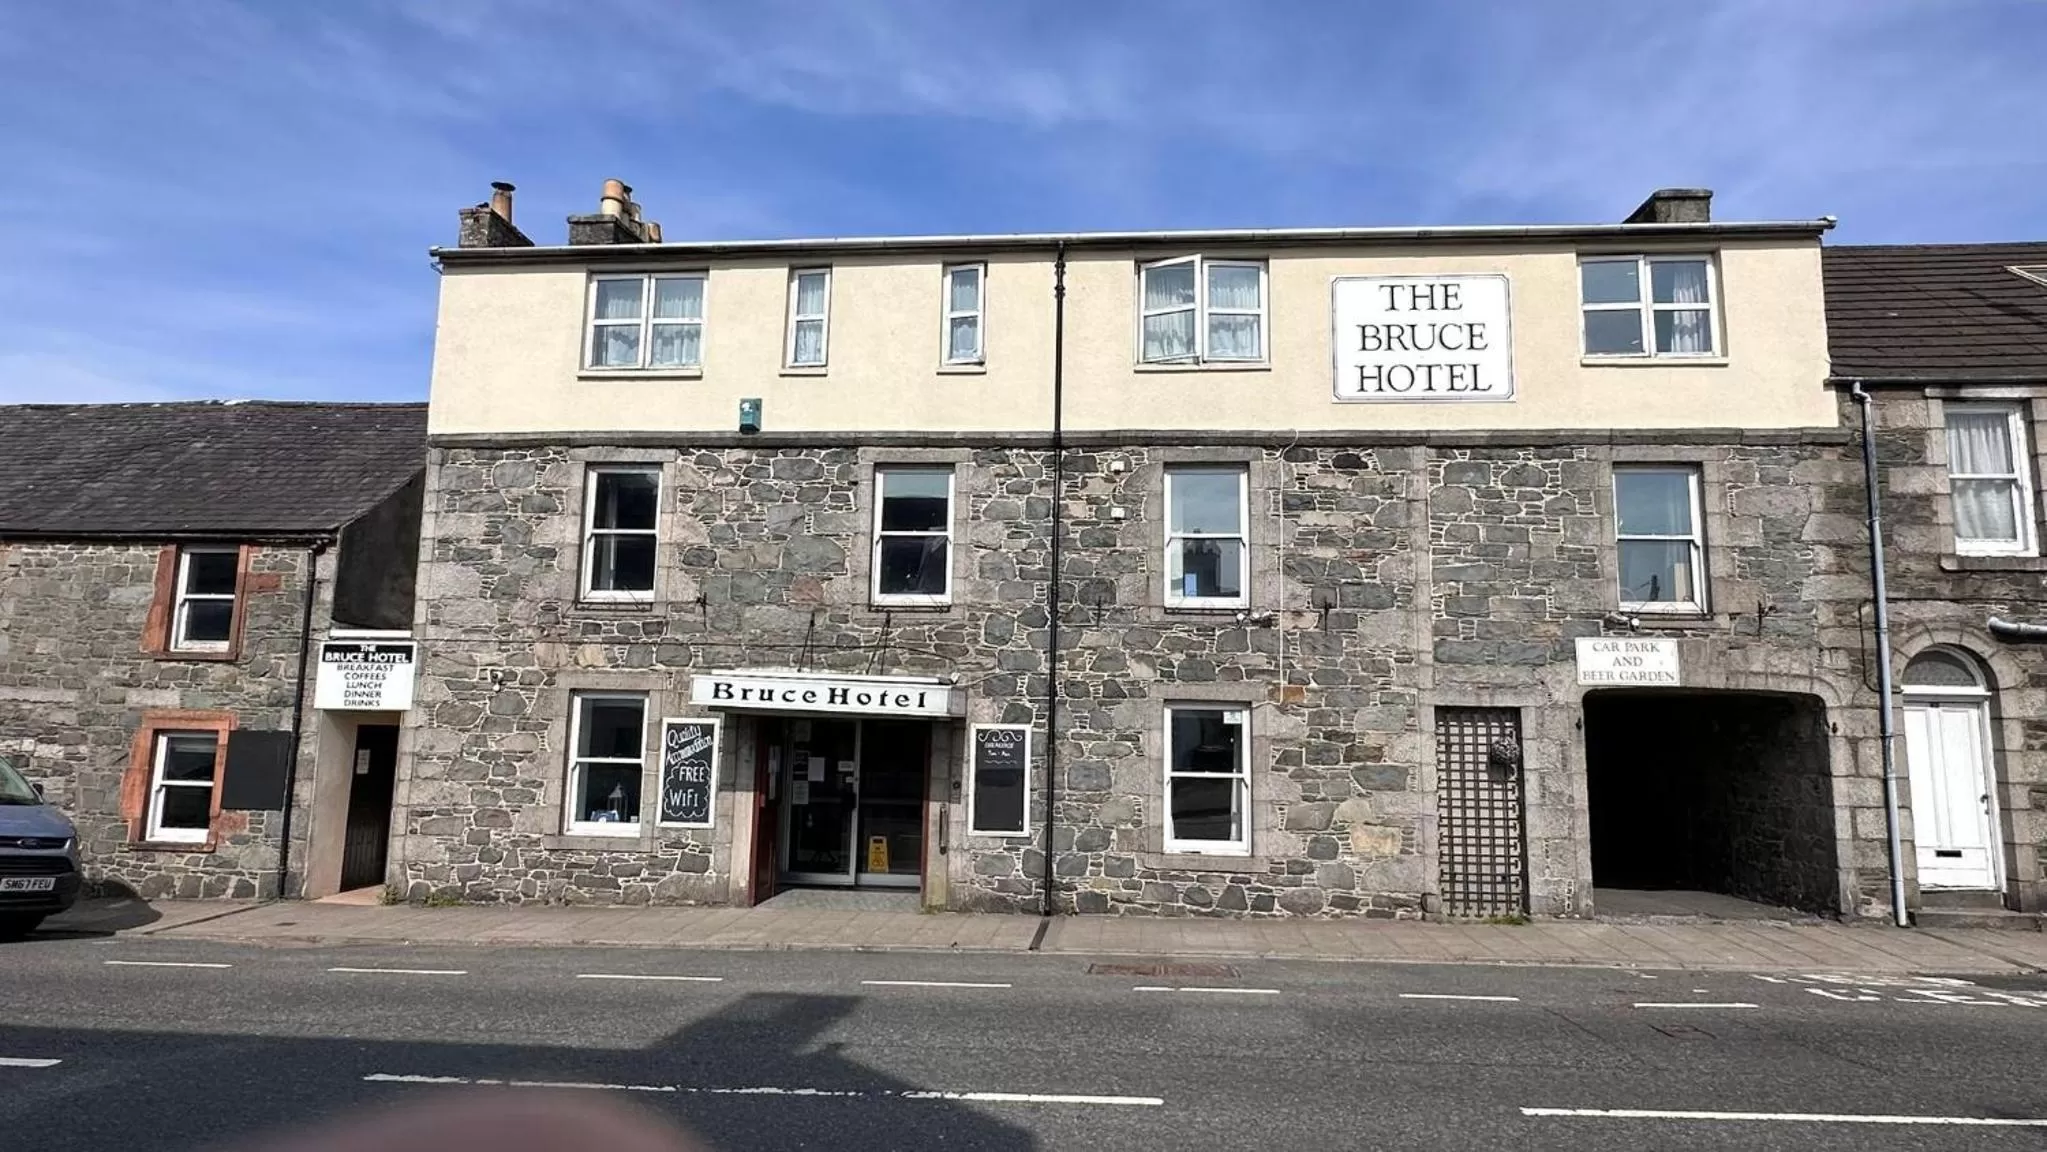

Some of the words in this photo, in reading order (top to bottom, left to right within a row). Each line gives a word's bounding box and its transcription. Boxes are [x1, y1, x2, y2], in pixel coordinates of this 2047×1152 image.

[1378, 283, 1463, 312] THE
[1356, 322, 1489, 352] BRUCE
[1354, 363, 1493, 393] HOTEL
[359, 644, 376, 652] THE
[1592, 642, 1621, 653] CAR
[1625, 642, 1660, 653] PARK
[325, 652, 364, 662] BRUCE
[368, 653, 409, 663] HOTEL
[1612, 656, 1643, 667] AND
[336, 664, 395, 672] BREAKFAST
[343, 672, 387, 681] COFFEES
[1583, 670, 1614, 681] BEER
[1619, 671, 1675, 682] GARDEN
[346, 681, 383, 689] LUNCH
[344, 690, 382, 698] DINNER
[712, 682, 818, 704] Bruce
[827, 687, 928, 709] Hotel
[343, 699, 381, 707] DRINKS
[678, 766, 705, 783] FREE
